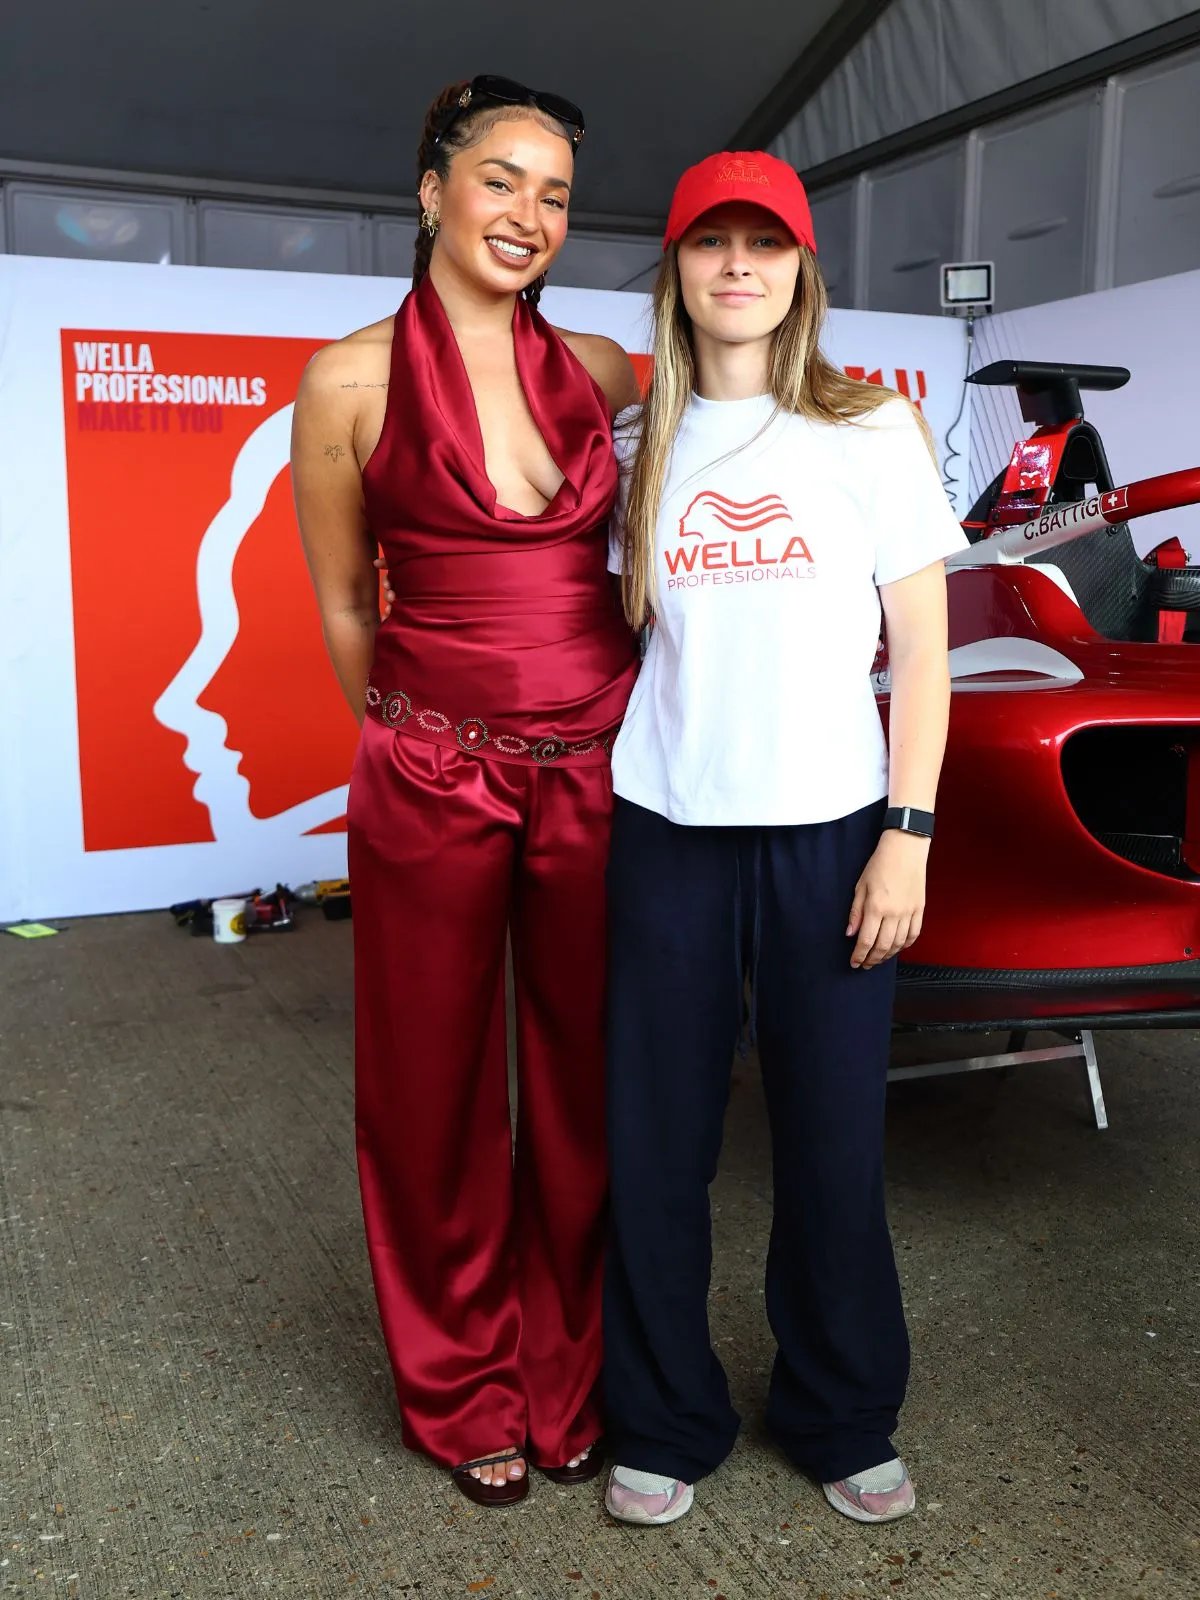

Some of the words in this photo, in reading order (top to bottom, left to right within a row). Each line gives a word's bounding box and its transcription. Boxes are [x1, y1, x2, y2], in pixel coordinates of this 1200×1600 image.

[73, 341, 154, 372] WELLA
[76, 372, 267, 406] PROFESSIONALS
[77, 402, 145, 431] MAKE
[149, 404, 171, 432] IT
[175, 405, 223, 433] YOU
[664, 536, 814, 576] WELLA
[667, 565, 817, 592] PROFESSIONALS
